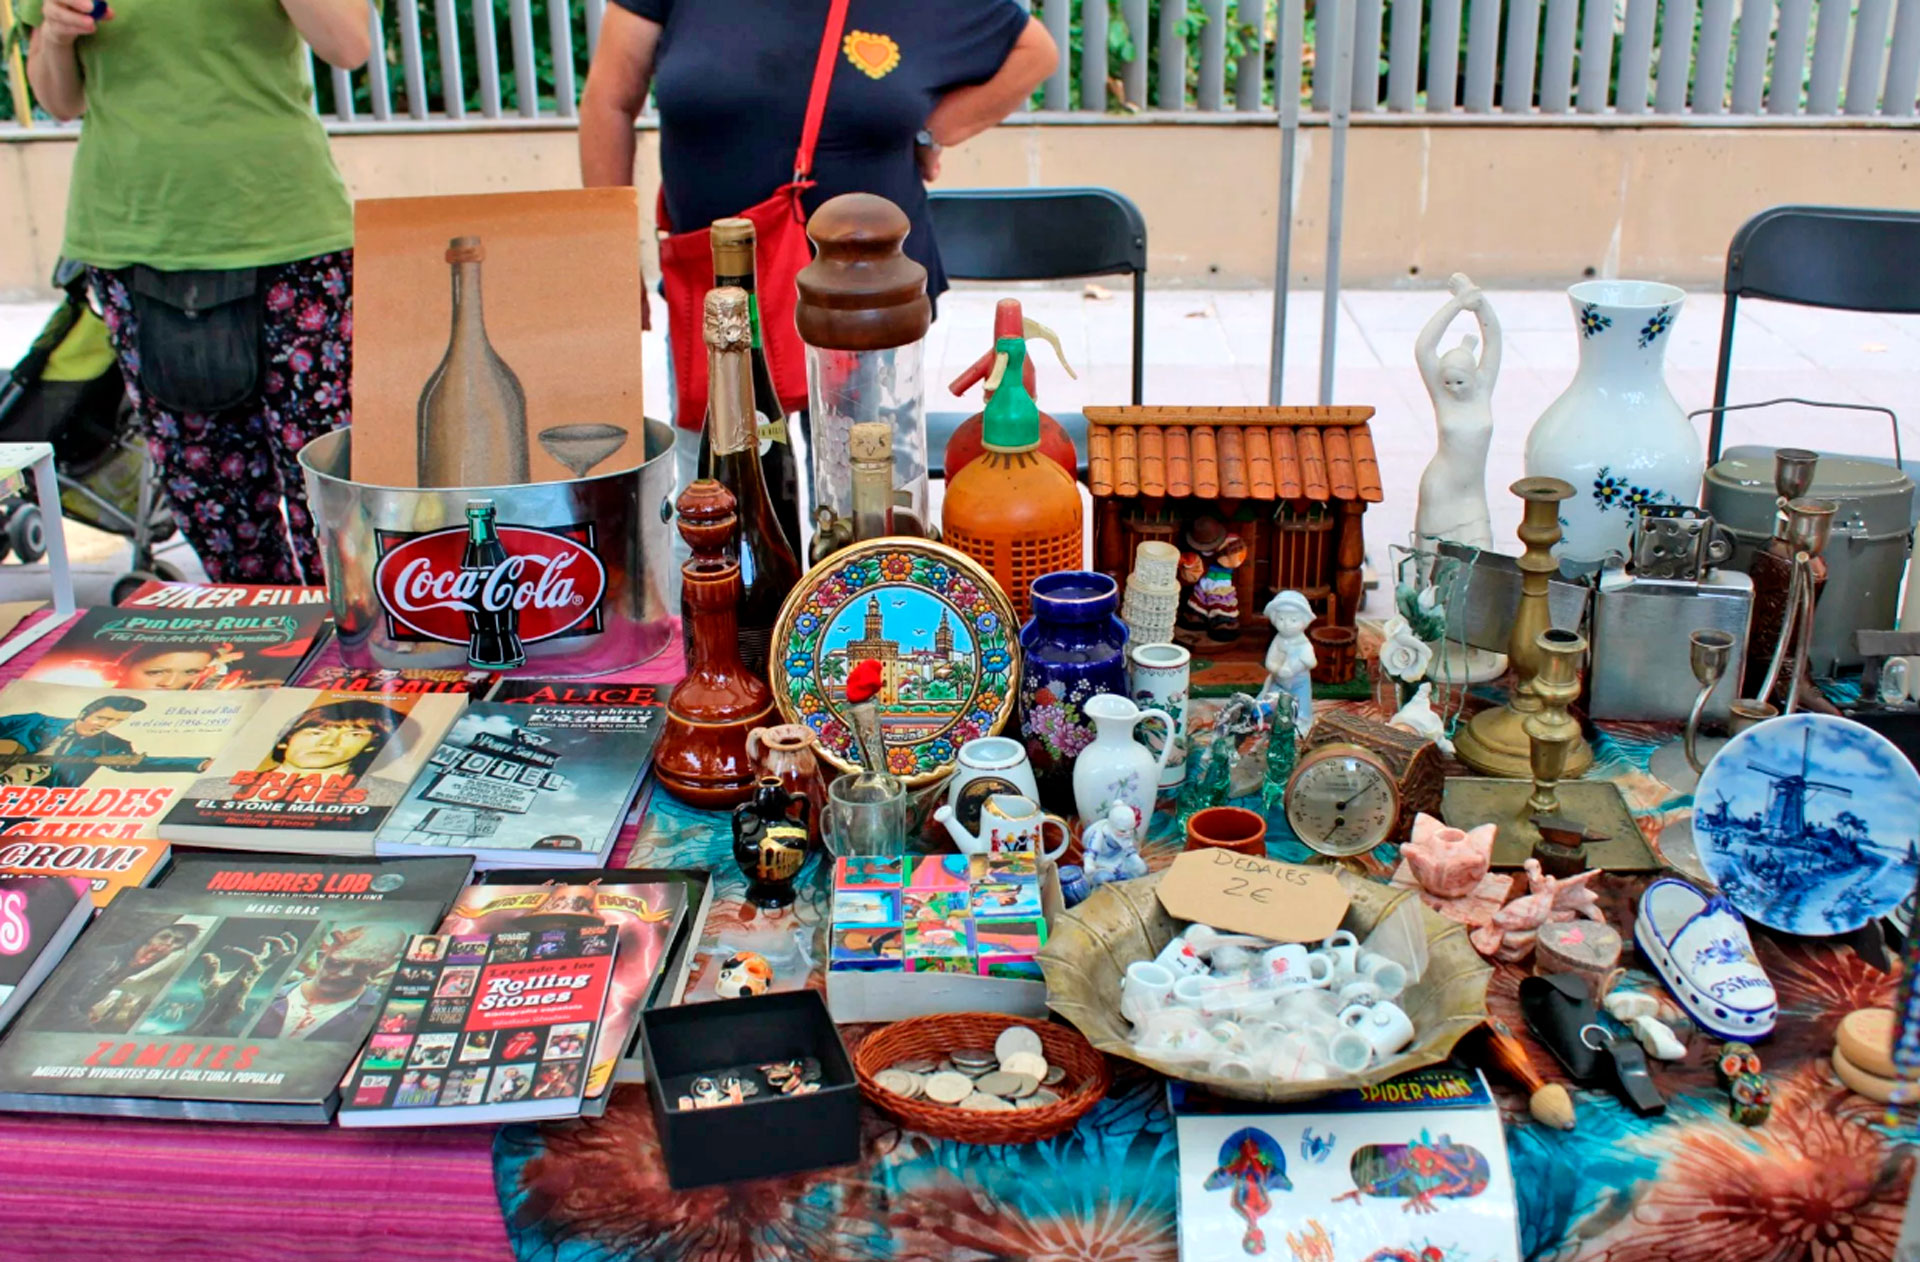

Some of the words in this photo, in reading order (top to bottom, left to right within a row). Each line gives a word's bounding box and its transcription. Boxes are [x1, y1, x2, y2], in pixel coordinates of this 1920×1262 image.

[394, 551, 580, 612] Coca-Cola
[132, 584, 247, 609] BIKER
[249, 588, 330, 606] FILM
[530, 685, 657, 703] ALICE
[436, 746, 560, 789] MOTEL
[229, 770, 356, 788] BRIAN
[232, 785, 370, 804] JONES
[195, 799, 217, 809] EL
[222, 800, 285, 812] STONE
[287, 802, 371, 815] MALDITO
[225, 817, 269, 827] Rolling
[271, 818, 316, 828] Stones
[0, 842, 148, 871] CROM!
[1212, 850, 1311, 887] DEDALES
[206, 870, 324, 893] HOMBRES
[1222, 877, 1273, 904] 2€
[245, 903, 281, 914] MARC
[284, 905, 321, 916] GRAS
[598, 894, 643, 913] ROCK
[490, 966, 554, 977] Leyendo
[573, 962, 595, 970] los
[487, 974, 592, 996] Rolling
[477, 991, 573, 1010] Stones
[84, 1040, 261, 1071] ZOMBIES
[31, 1065, 87, 1079] MUERTOS
[88, 1066, 147, 1081] VIVIENTES
[146, 1068, 164, 1081] EN
[164, 1069, 179, 1081] LA
[179, 1069, 232, 1083] CULTURA
[232, 1072, 285, 1085] POPULAR
